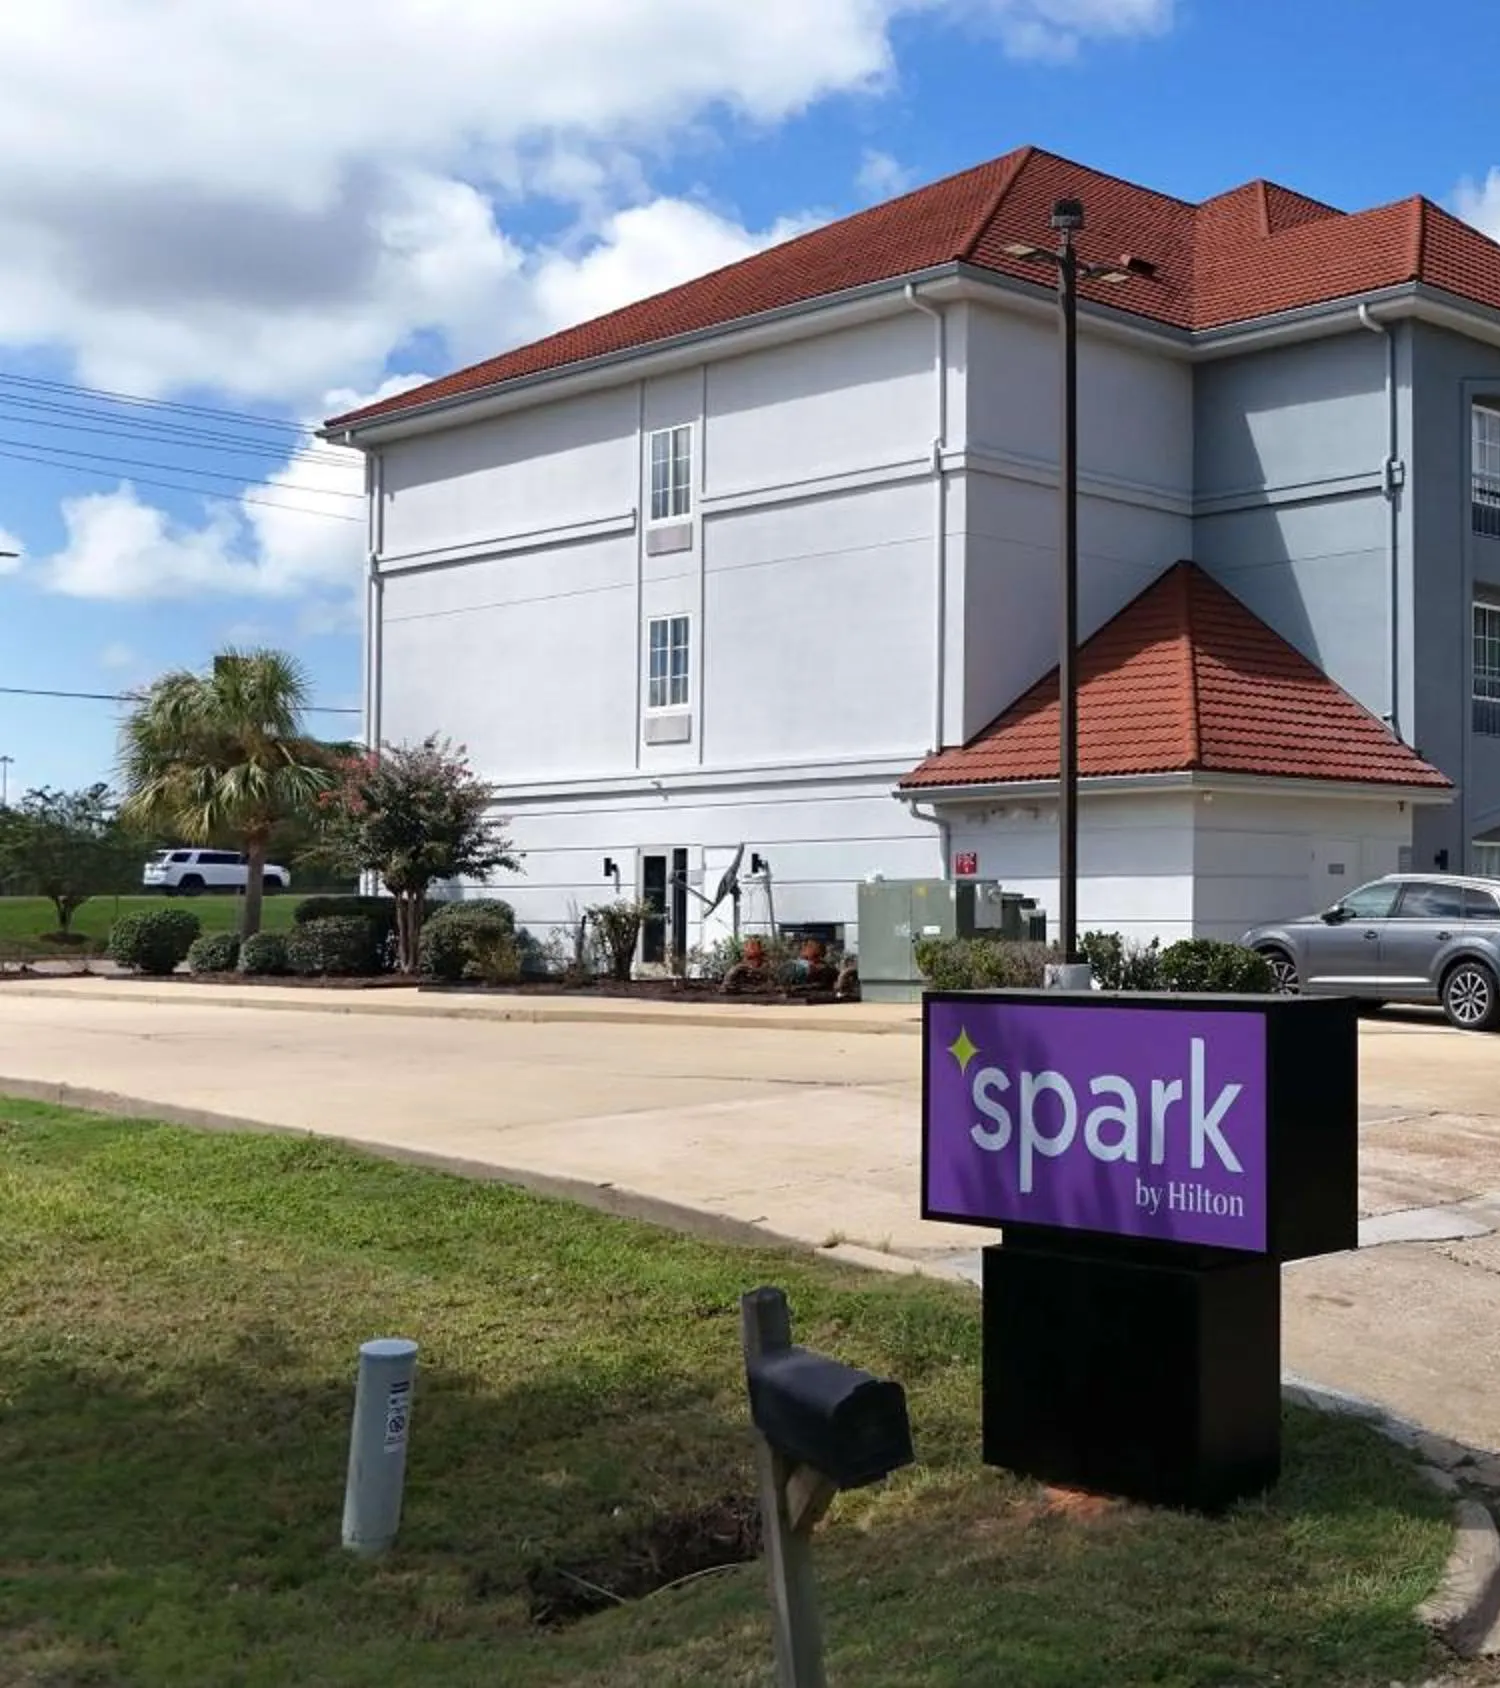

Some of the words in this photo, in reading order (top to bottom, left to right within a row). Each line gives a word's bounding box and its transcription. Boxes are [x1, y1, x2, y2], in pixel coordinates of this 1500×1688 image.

[970, 1037, 1244, 1193] spark
[1136, 1177, 1162, 1216] by
[1168, 1181, 1244, 1217] Hilton
